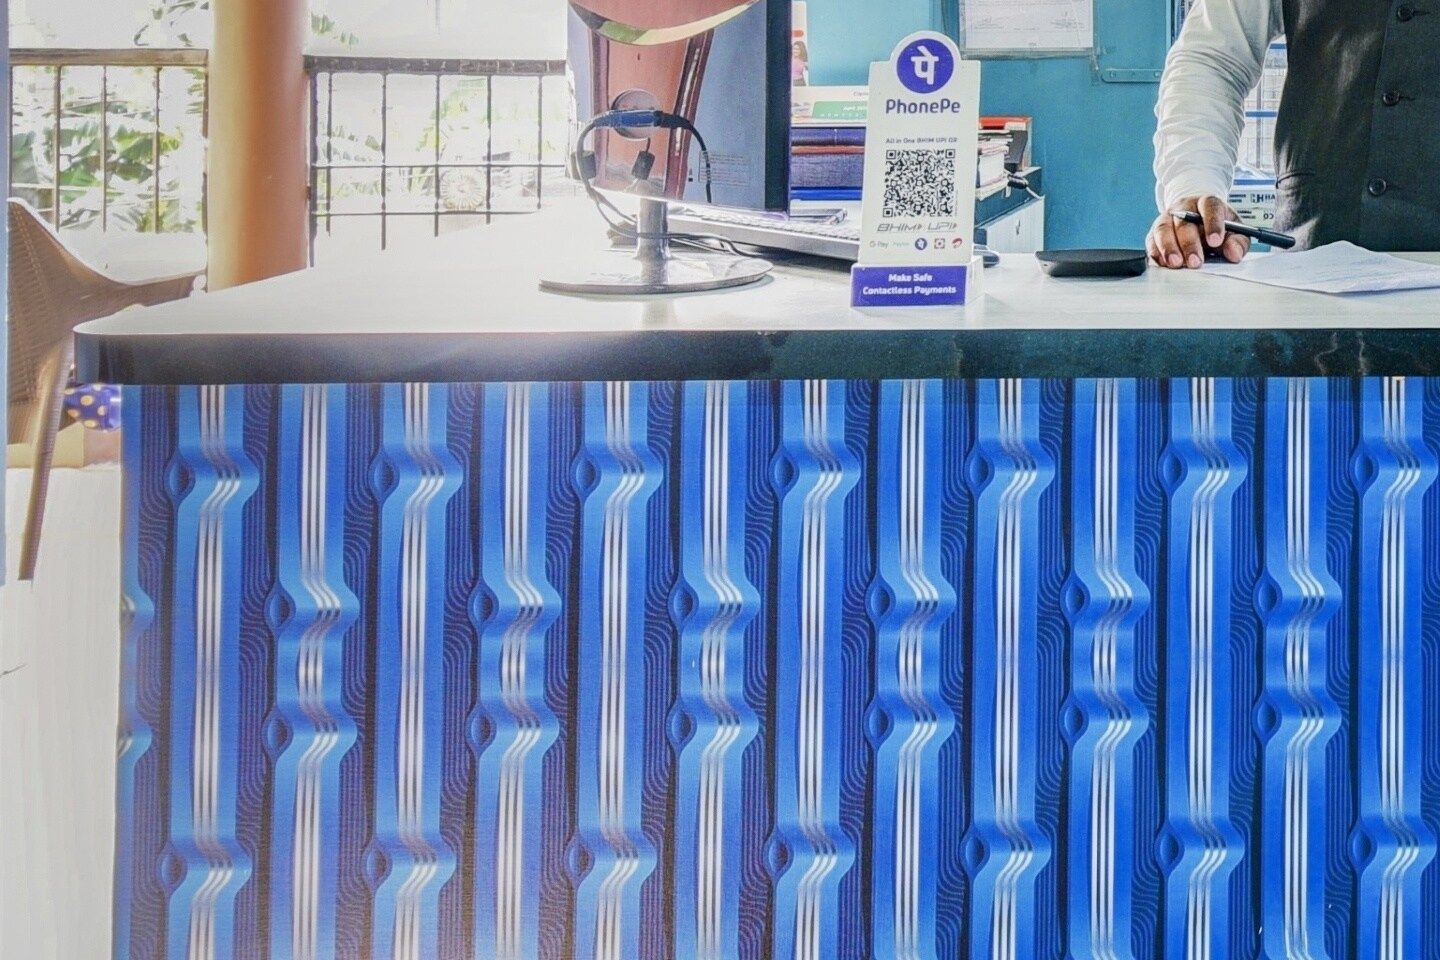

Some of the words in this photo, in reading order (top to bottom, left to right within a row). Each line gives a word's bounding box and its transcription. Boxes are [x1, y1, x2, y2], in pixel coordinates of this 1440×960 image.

[886, 99, 960, 114] PhonePe
[877, 222, 918, 232] BHIM
[928, 222, 953, 230] UPI
[888, 274, 912, 282] Make
[913, 273, 933, 282] Safe
[862, 286, 912, 294] Contactless
[914, 286, 957, 296] Payments
